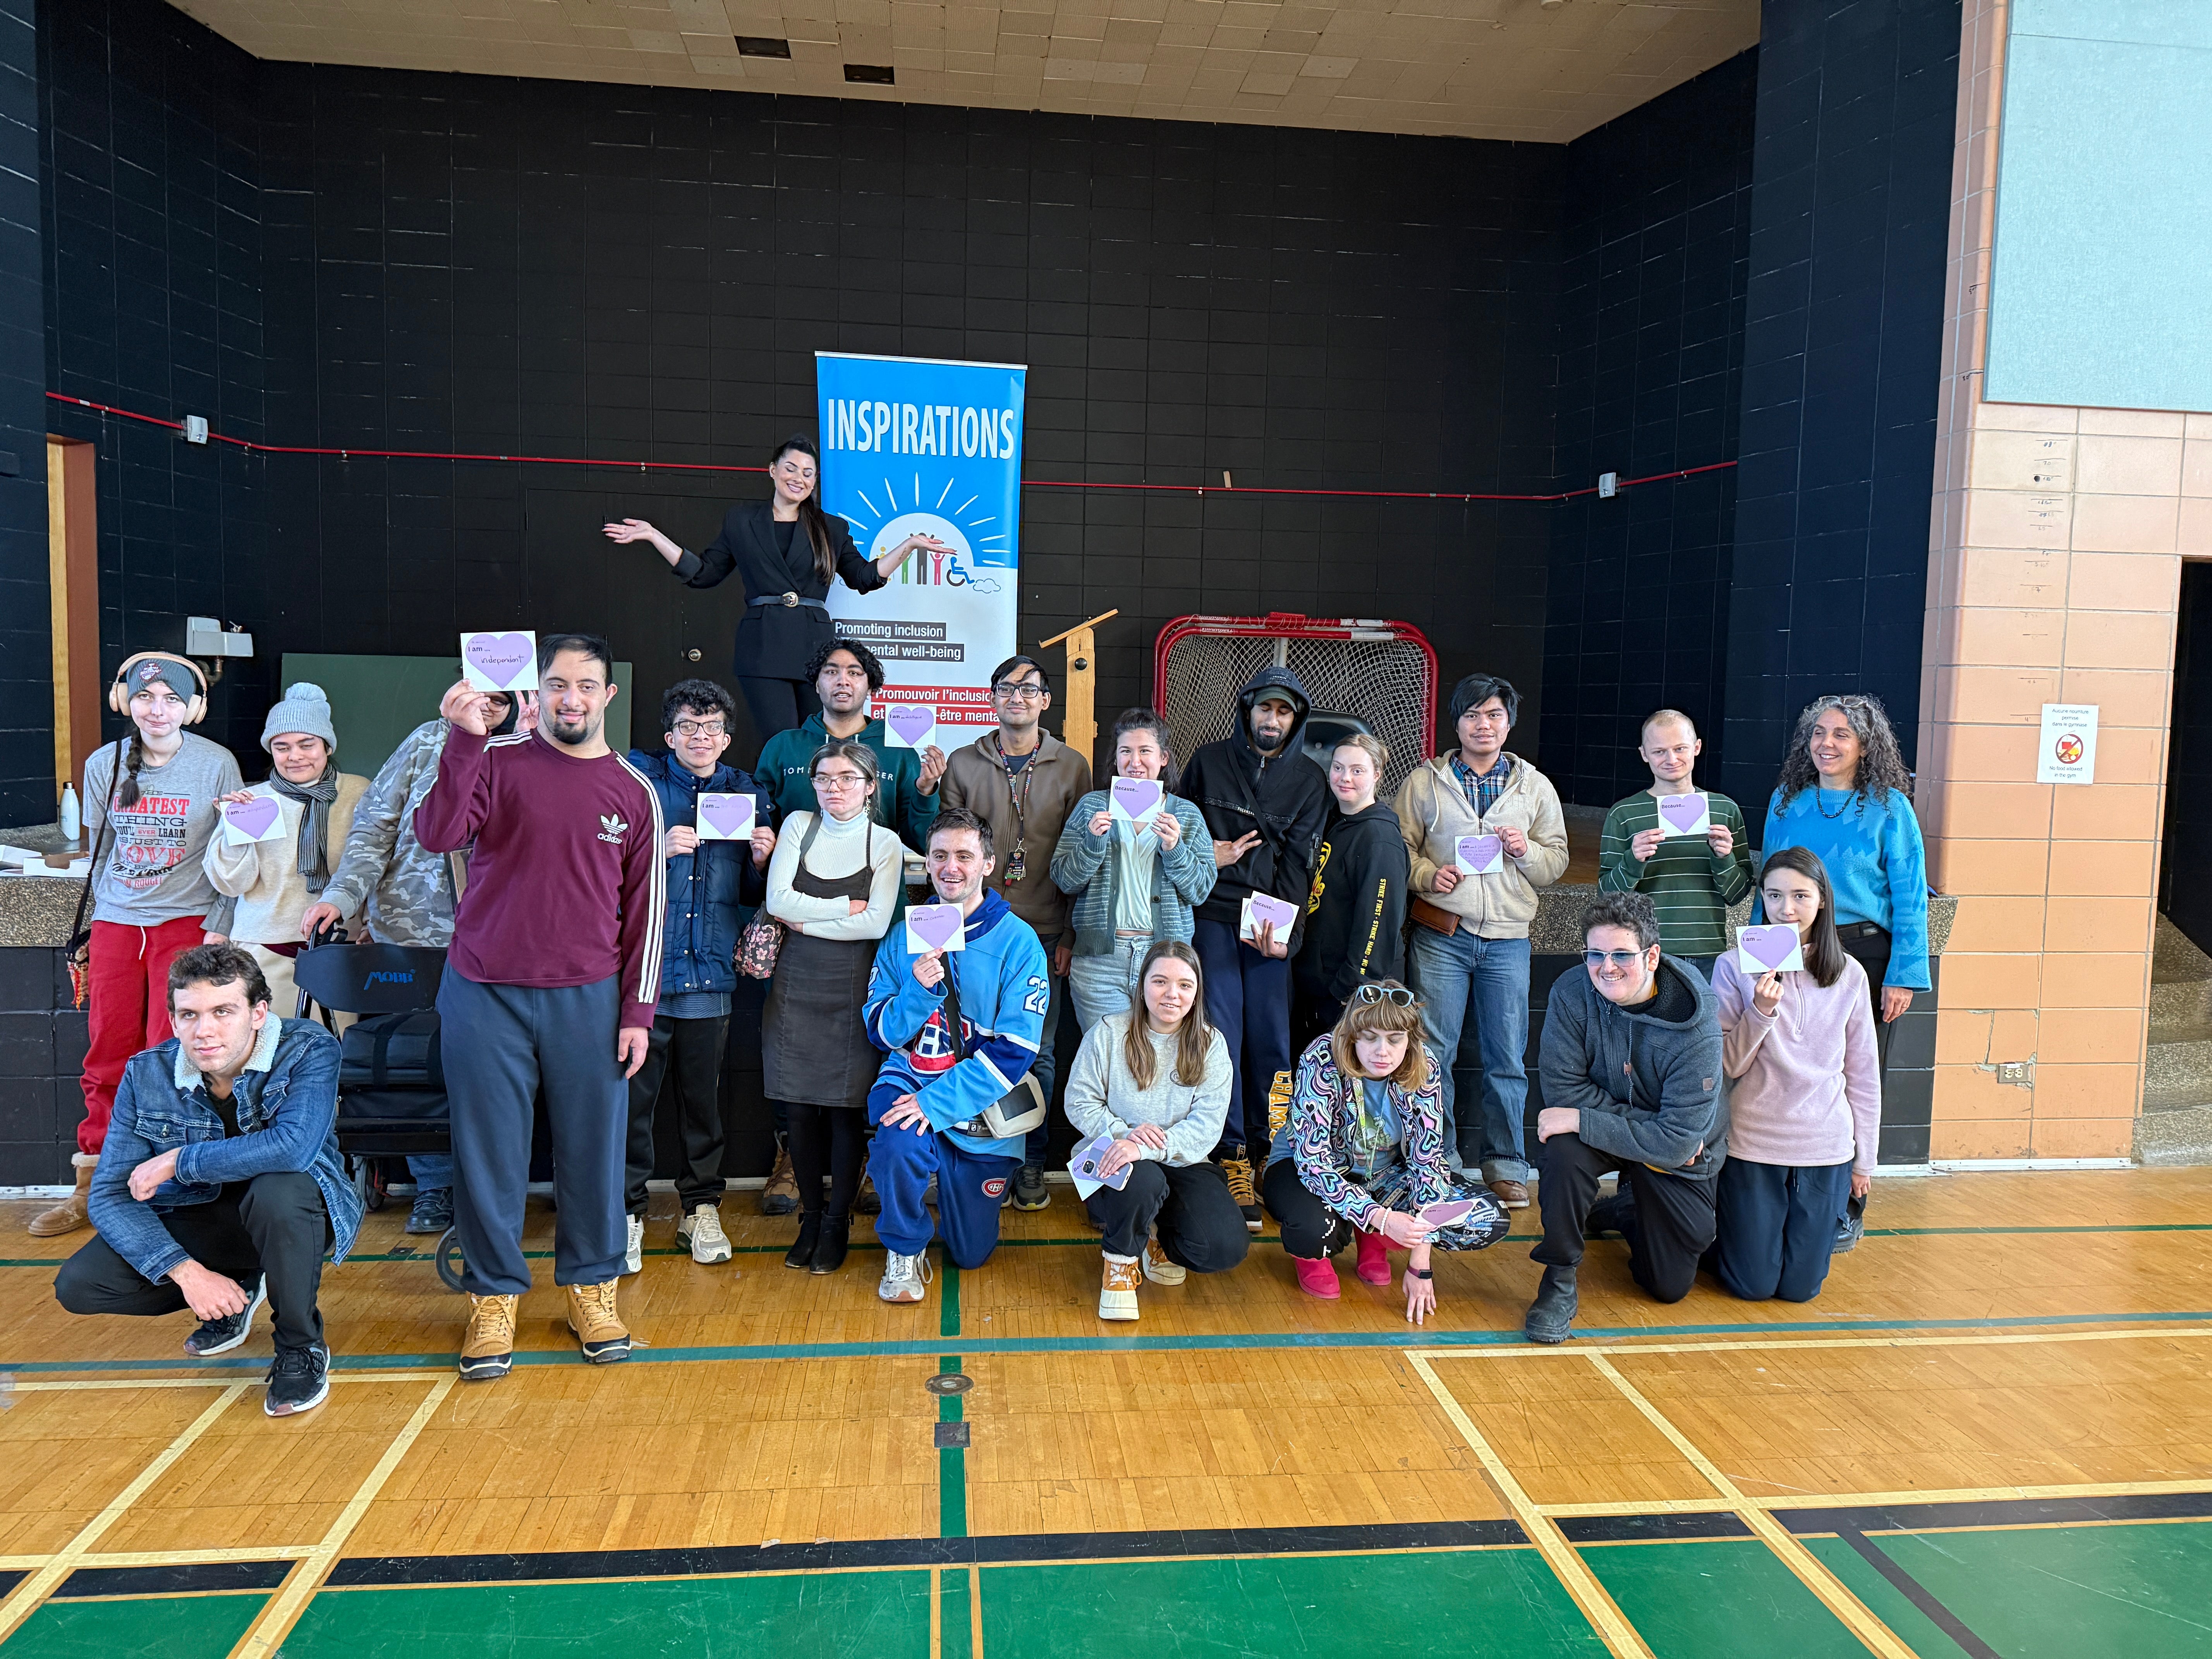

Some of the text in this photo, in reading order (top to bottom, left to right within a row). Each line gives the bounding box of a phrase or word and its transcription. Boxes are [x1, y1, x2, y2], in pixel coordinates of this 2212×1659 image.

[828, 398, 1014, 459] INSPIRATIONS
[835, 622, 943, 638] Promoting inclusion
[902, 645, 961, 661] well-being
[876, 687, 991, 702] Promouvoir l'inclusio
[873, 708, 1000, 722] et -être menta
[783, 766, 811, 776] TOM
[114, 815, 187, 827] THING
[158, 828, 186, 838] LEARN
[597, 832, 623, 845] adidas
[1377, 878, 1386, 898] STRIKE
[1374, 899, 1383, 916] FIRST
[1369, 920, 1379, 940] STRIKE
[1364, 941, 1374, 956] HARD
[1361, 958, 1369, 967] NO
[1022, 975, 1048, 1017] 22
[1268, 1070, 1293, 1144] CHAM
[1073, 1162, 1084, 1172] Beca
